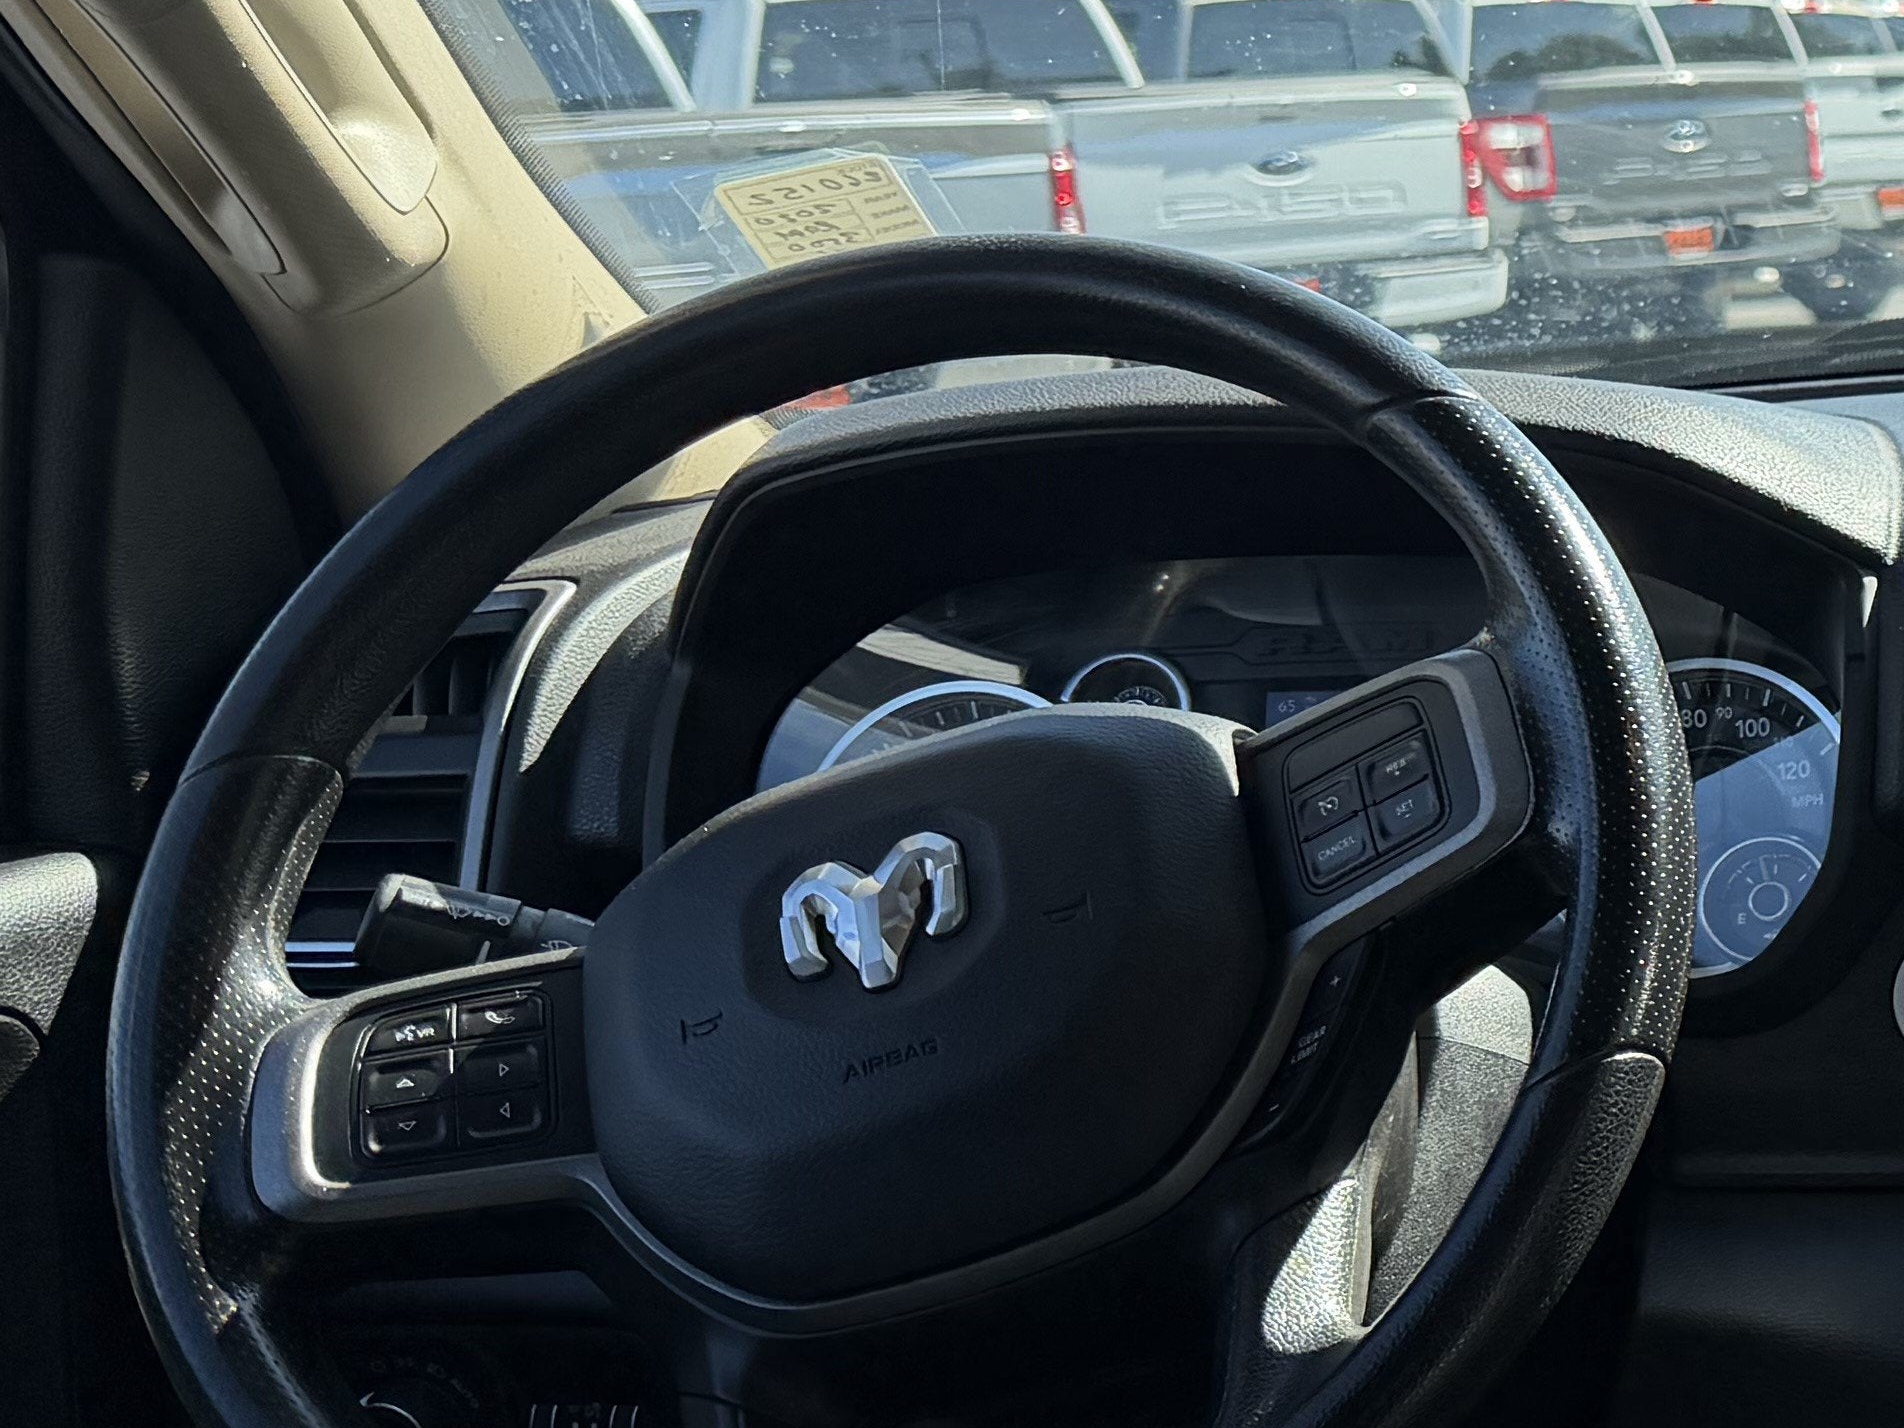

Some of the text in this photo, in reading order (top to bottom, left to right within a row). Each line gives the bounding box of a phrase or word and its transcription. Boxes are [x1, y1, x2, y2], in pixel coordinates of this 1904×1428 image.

[1277, 698, 1297, 714] 65
[1715, 706, 1733, 721] 90
[1681, 708, 1707, 729] 80
[1735, 717, 1770, 739] 100
[1777, 759, 1811, 781] 120
[1791, 792, 1824, 807] MPH
[1317, 835, 1357, 862] CANCEL
[842, 1037, 938, 1086] AIRBAG
